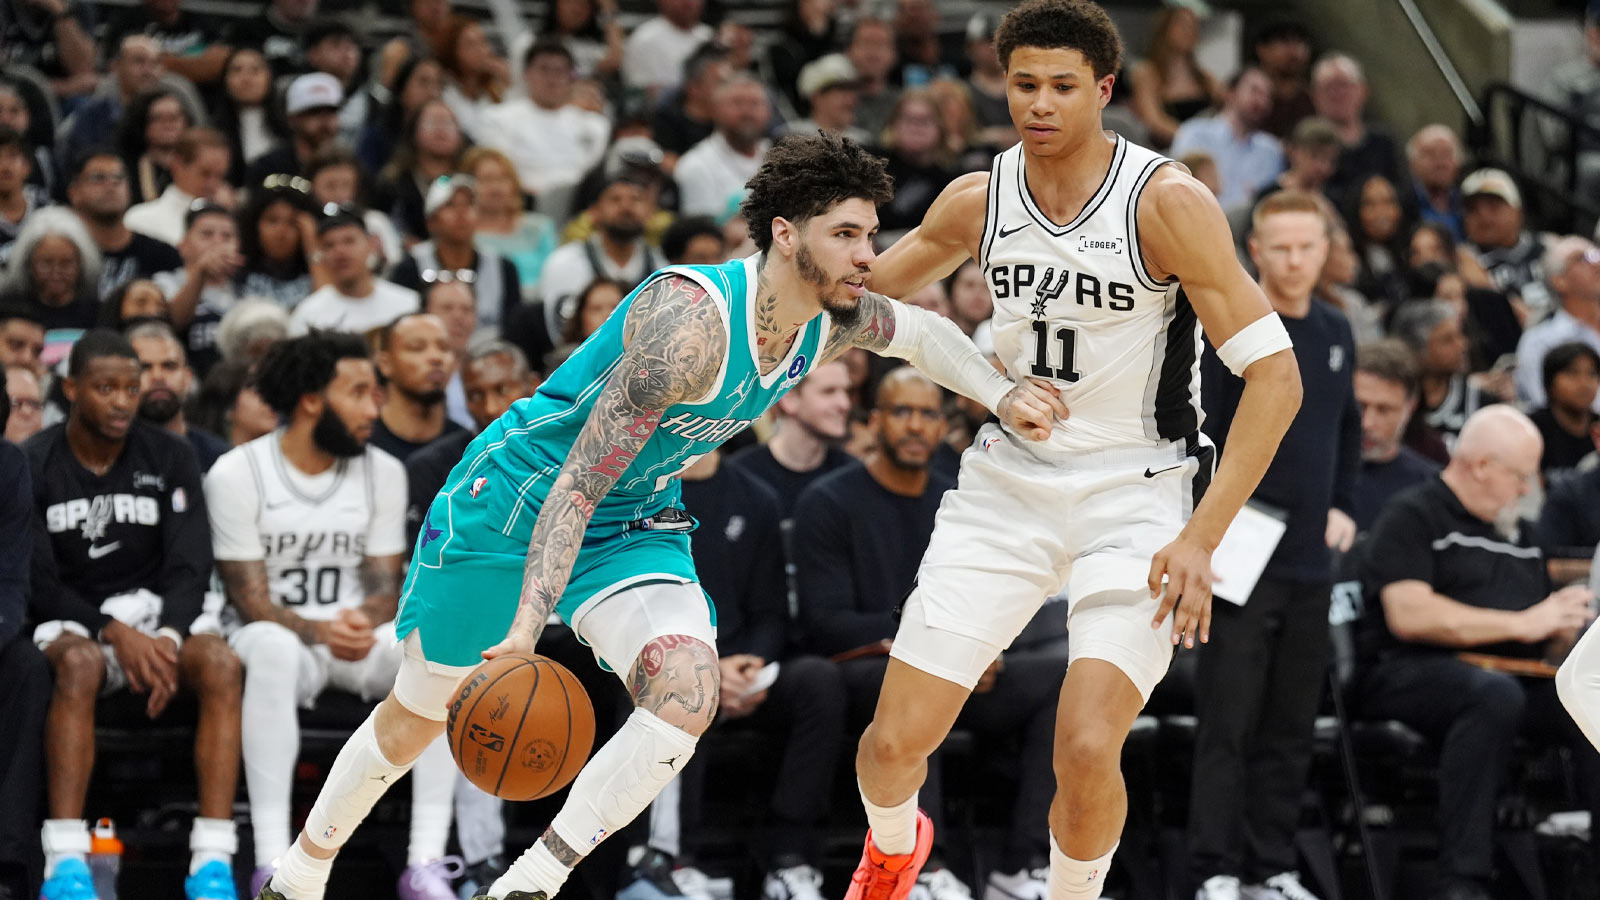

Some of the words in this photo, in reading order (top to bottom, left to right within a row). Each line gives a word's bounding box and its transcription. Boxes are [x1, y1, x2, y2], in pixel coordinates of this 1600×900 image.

[1084, 240, 1117, 250] LEDGER
[991, 264, 1135, 320] SPURS
[1029, 319, 1082, 383] 11
[46, 493, 160, 541] SPURS
[280, 566, 341, 607] 30
